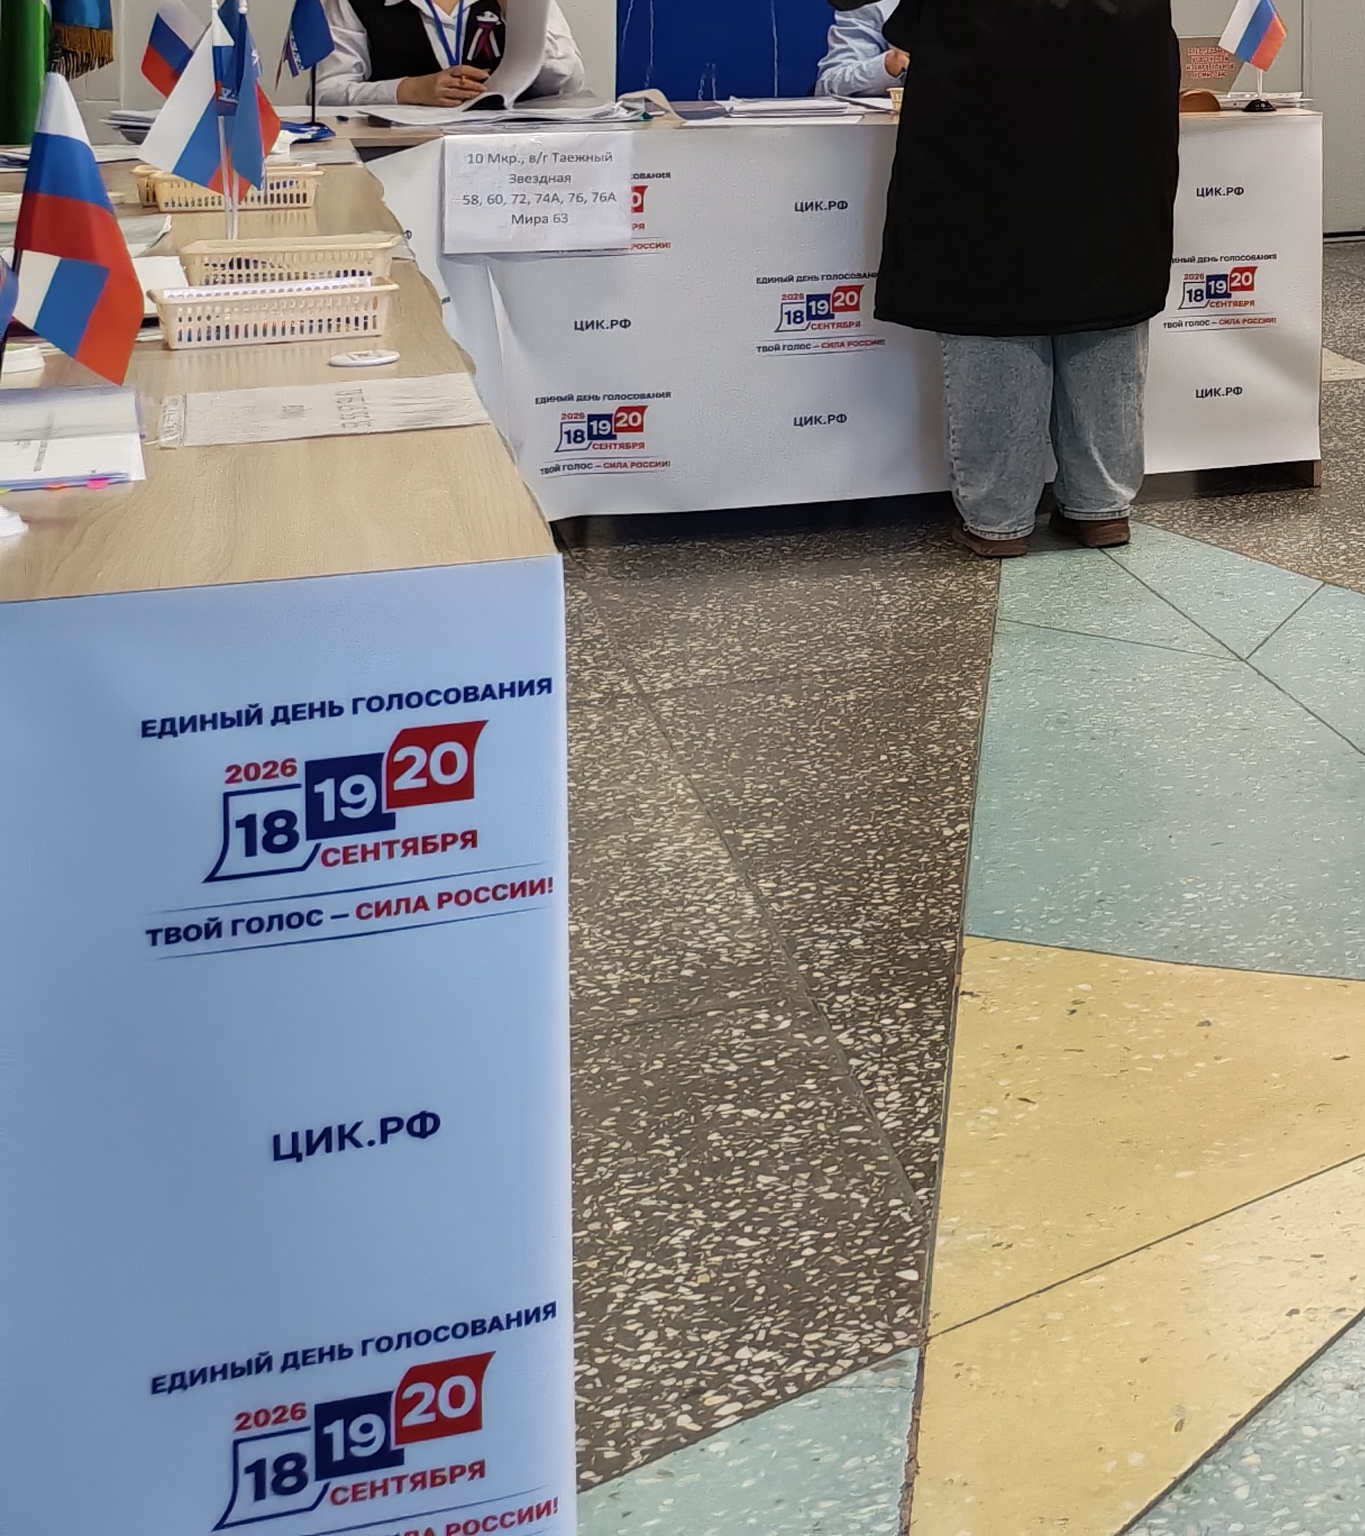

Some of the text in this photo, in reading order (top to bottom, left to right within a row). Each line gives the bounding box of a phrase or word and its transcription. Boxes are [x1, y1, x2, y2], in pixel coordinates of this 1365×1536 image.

[467, 153, 484, 164] 10
[529, 151, 548, 165] в/г
[552, 151, 613, 164] Таежный
[509, 173, 571, 185] Звездная
[1196, 185, 1244, 198] ЦИК.РФ
[462, 191, 617, 207] 58, 60, 72, 74А, 76, 76А
[795, 200, 848, 212] ЦИК.РФ
[512, 213, 569, 226] Мира 63
[1186, 272, 1252, 302] 18 19 20
[784, 292, 858, 325] 18 19 20
[574, 318, 632, 332] ЦИК.РФ
[1195, 386, 1243, 398] ЦИК.РФ
[564, 412, 641, 444] 18 19 20
[794, 413, 847, 427] ЦИК.РФ
[141, 678, 552, 739] ЕДИНЫЙ ДЕНЬ ГОЛОСОВАНИЯ
[225, 758, 297, 784] 2026
[235, 741, 469, 857] 18 19 20
[320, 830, 478, 867] СЕНТЯБРЯ
[146, 877, 554, 946] ТВОЙ ГОЛОС СИЛА РОССИИ!
[272, 1109, 441, 1164] ЦИК.РФ
[151, 1301, 557, 1395] ЕДИНЫЙ ДЕНЬ ГОЛОСОВАНИЯ
[234, 1402, 307, 1432] 2026
[244, 1375, 476, 1503] 18 19 20
[330, 1459, 485, 1506] СЕНТЯБРЯ
[446, 1497, 559, 1536] РОССИИ!
